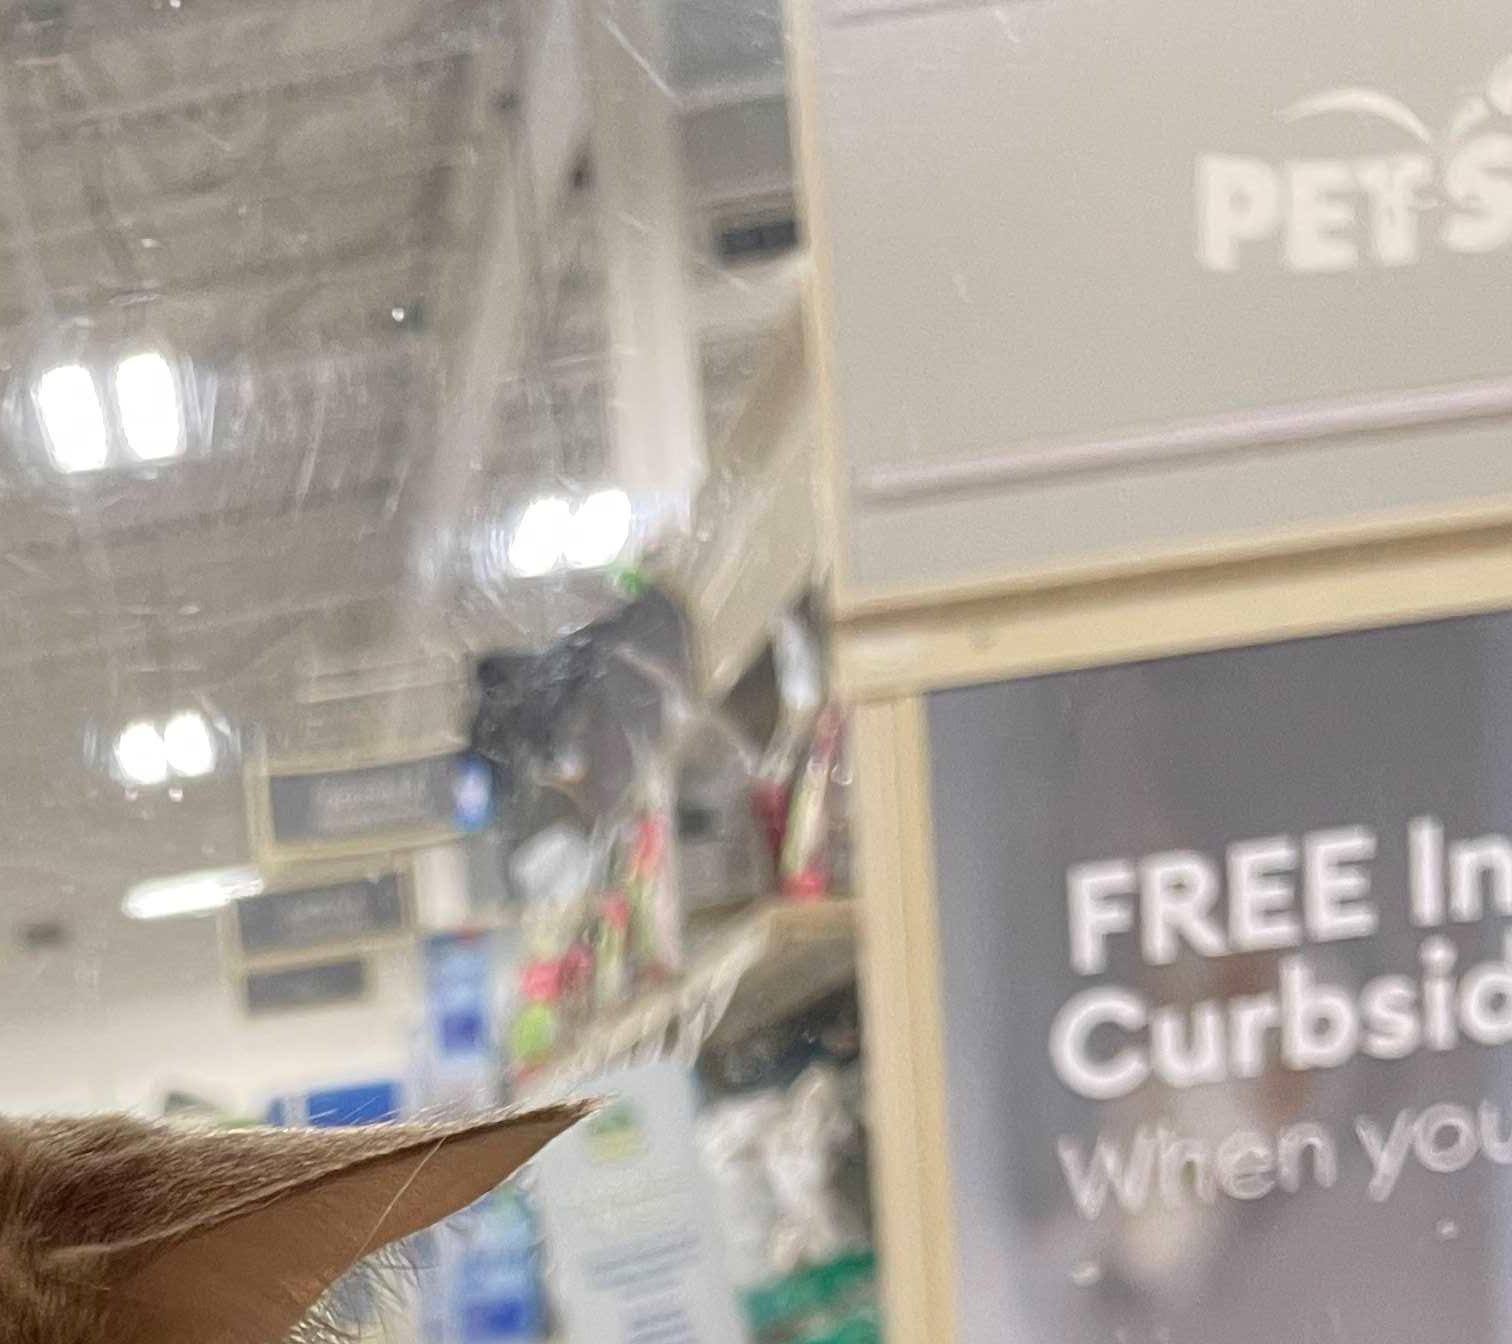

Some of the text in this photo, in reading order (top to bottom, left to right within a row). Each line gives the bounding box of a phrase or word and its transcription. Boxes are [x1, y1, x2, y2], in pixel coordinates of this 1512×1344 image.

[1065, 814, 1512, 976] FREE In
[1056, 1120, 1338, 1220] When
